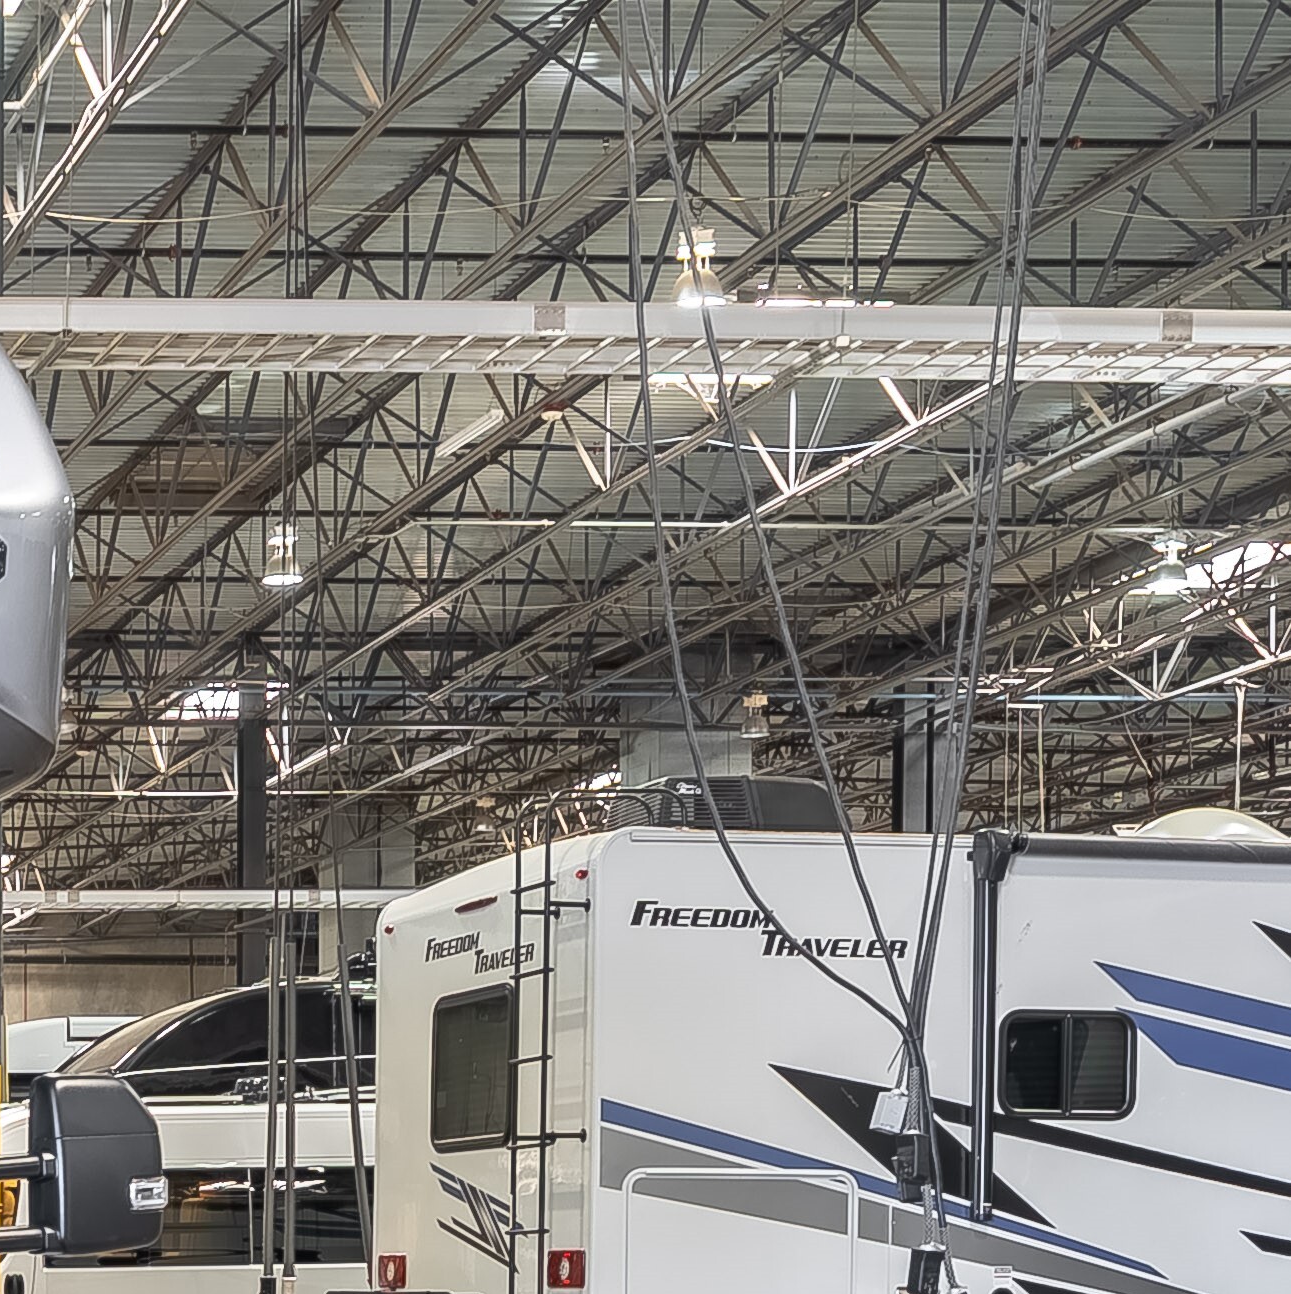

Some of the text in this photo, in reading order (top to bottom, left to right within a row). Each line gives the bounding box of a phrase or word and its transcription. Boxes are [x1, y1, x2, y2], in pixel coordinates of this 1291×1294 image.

[630, 900, 774, 929] FREEDOM
[425, 931, 481, 963] FREEDOM
[760, 930, 909, 958] TRAVELER
